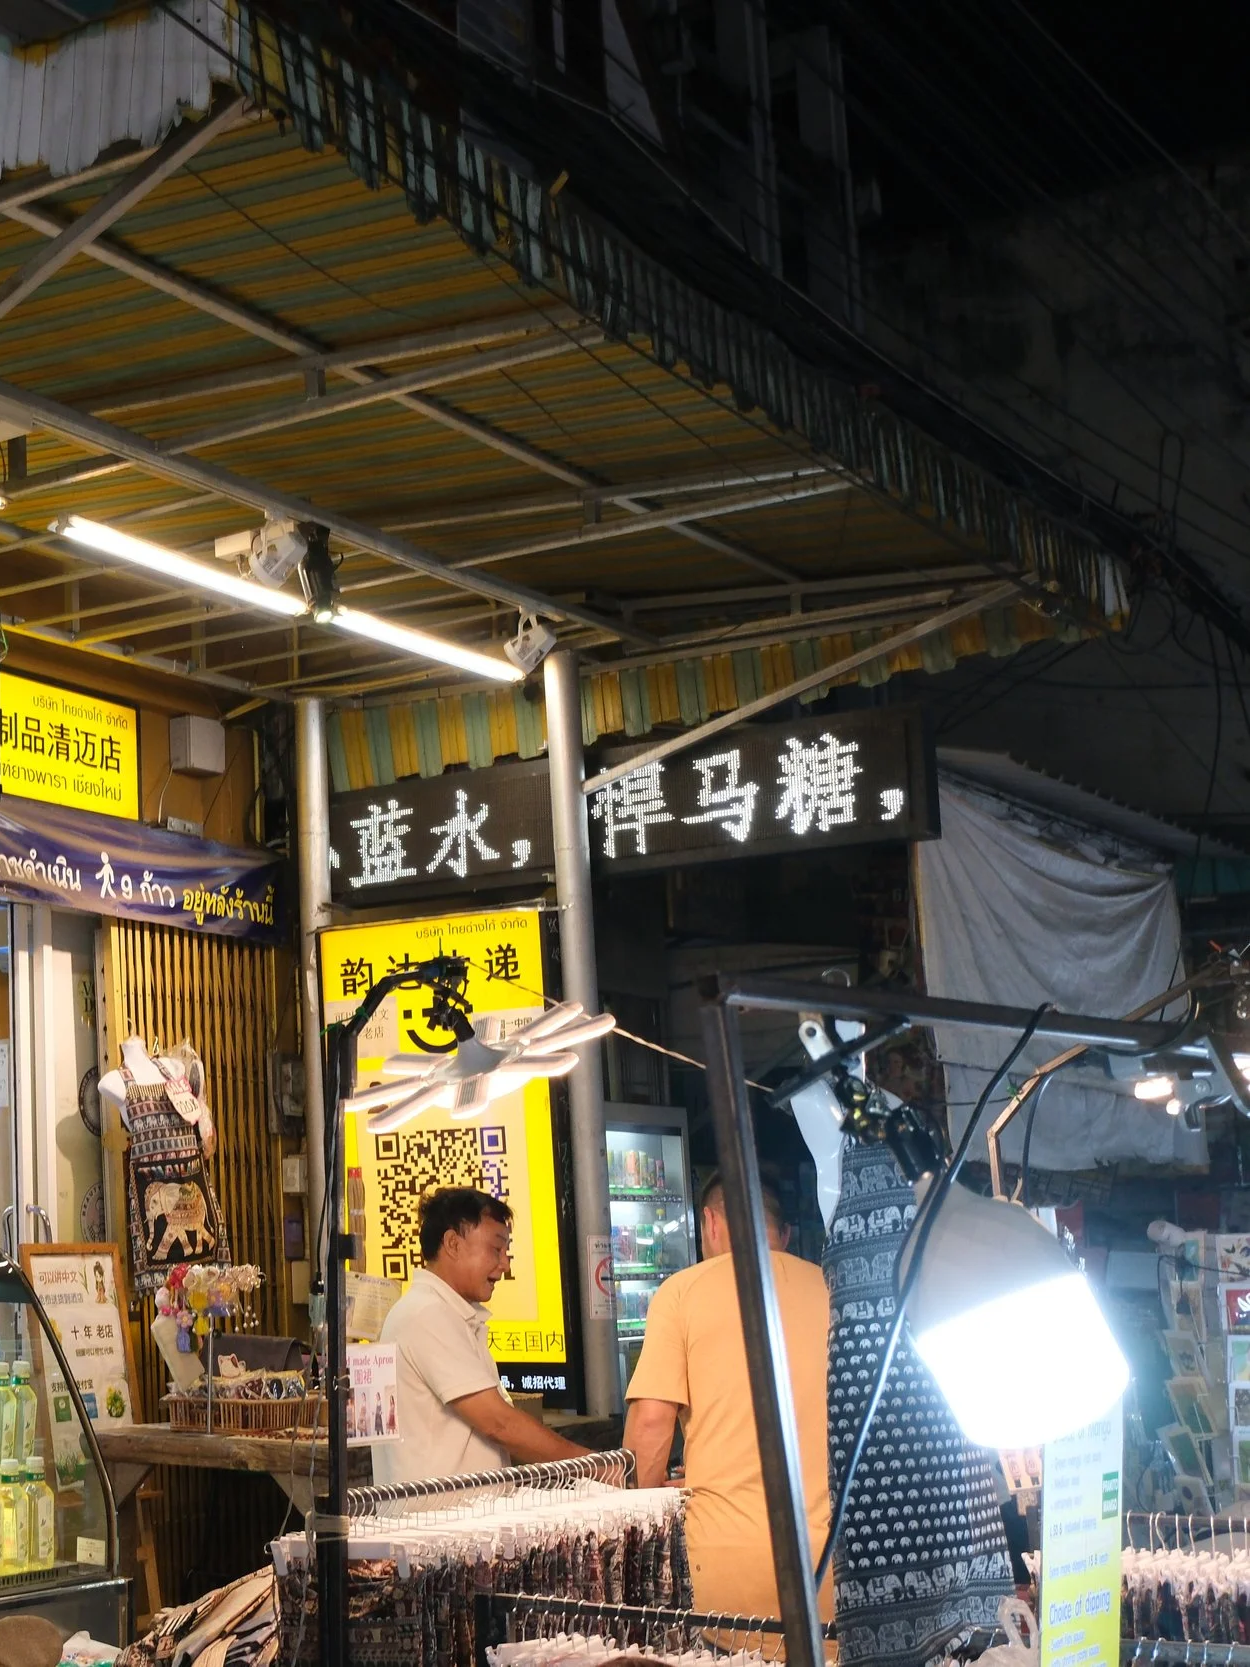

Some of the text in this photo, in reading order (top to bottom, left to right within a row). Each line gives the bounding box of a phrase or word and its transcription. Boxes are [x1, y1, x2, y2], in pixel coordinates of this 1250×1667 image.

[73, 774, 122, 802] เชียงใหม่
[140, 870, 176, 908] ก้าว
[373, 1353, 394, 1368] Apron
[1049, 1588, 1111, 1625] Choice of dipping
